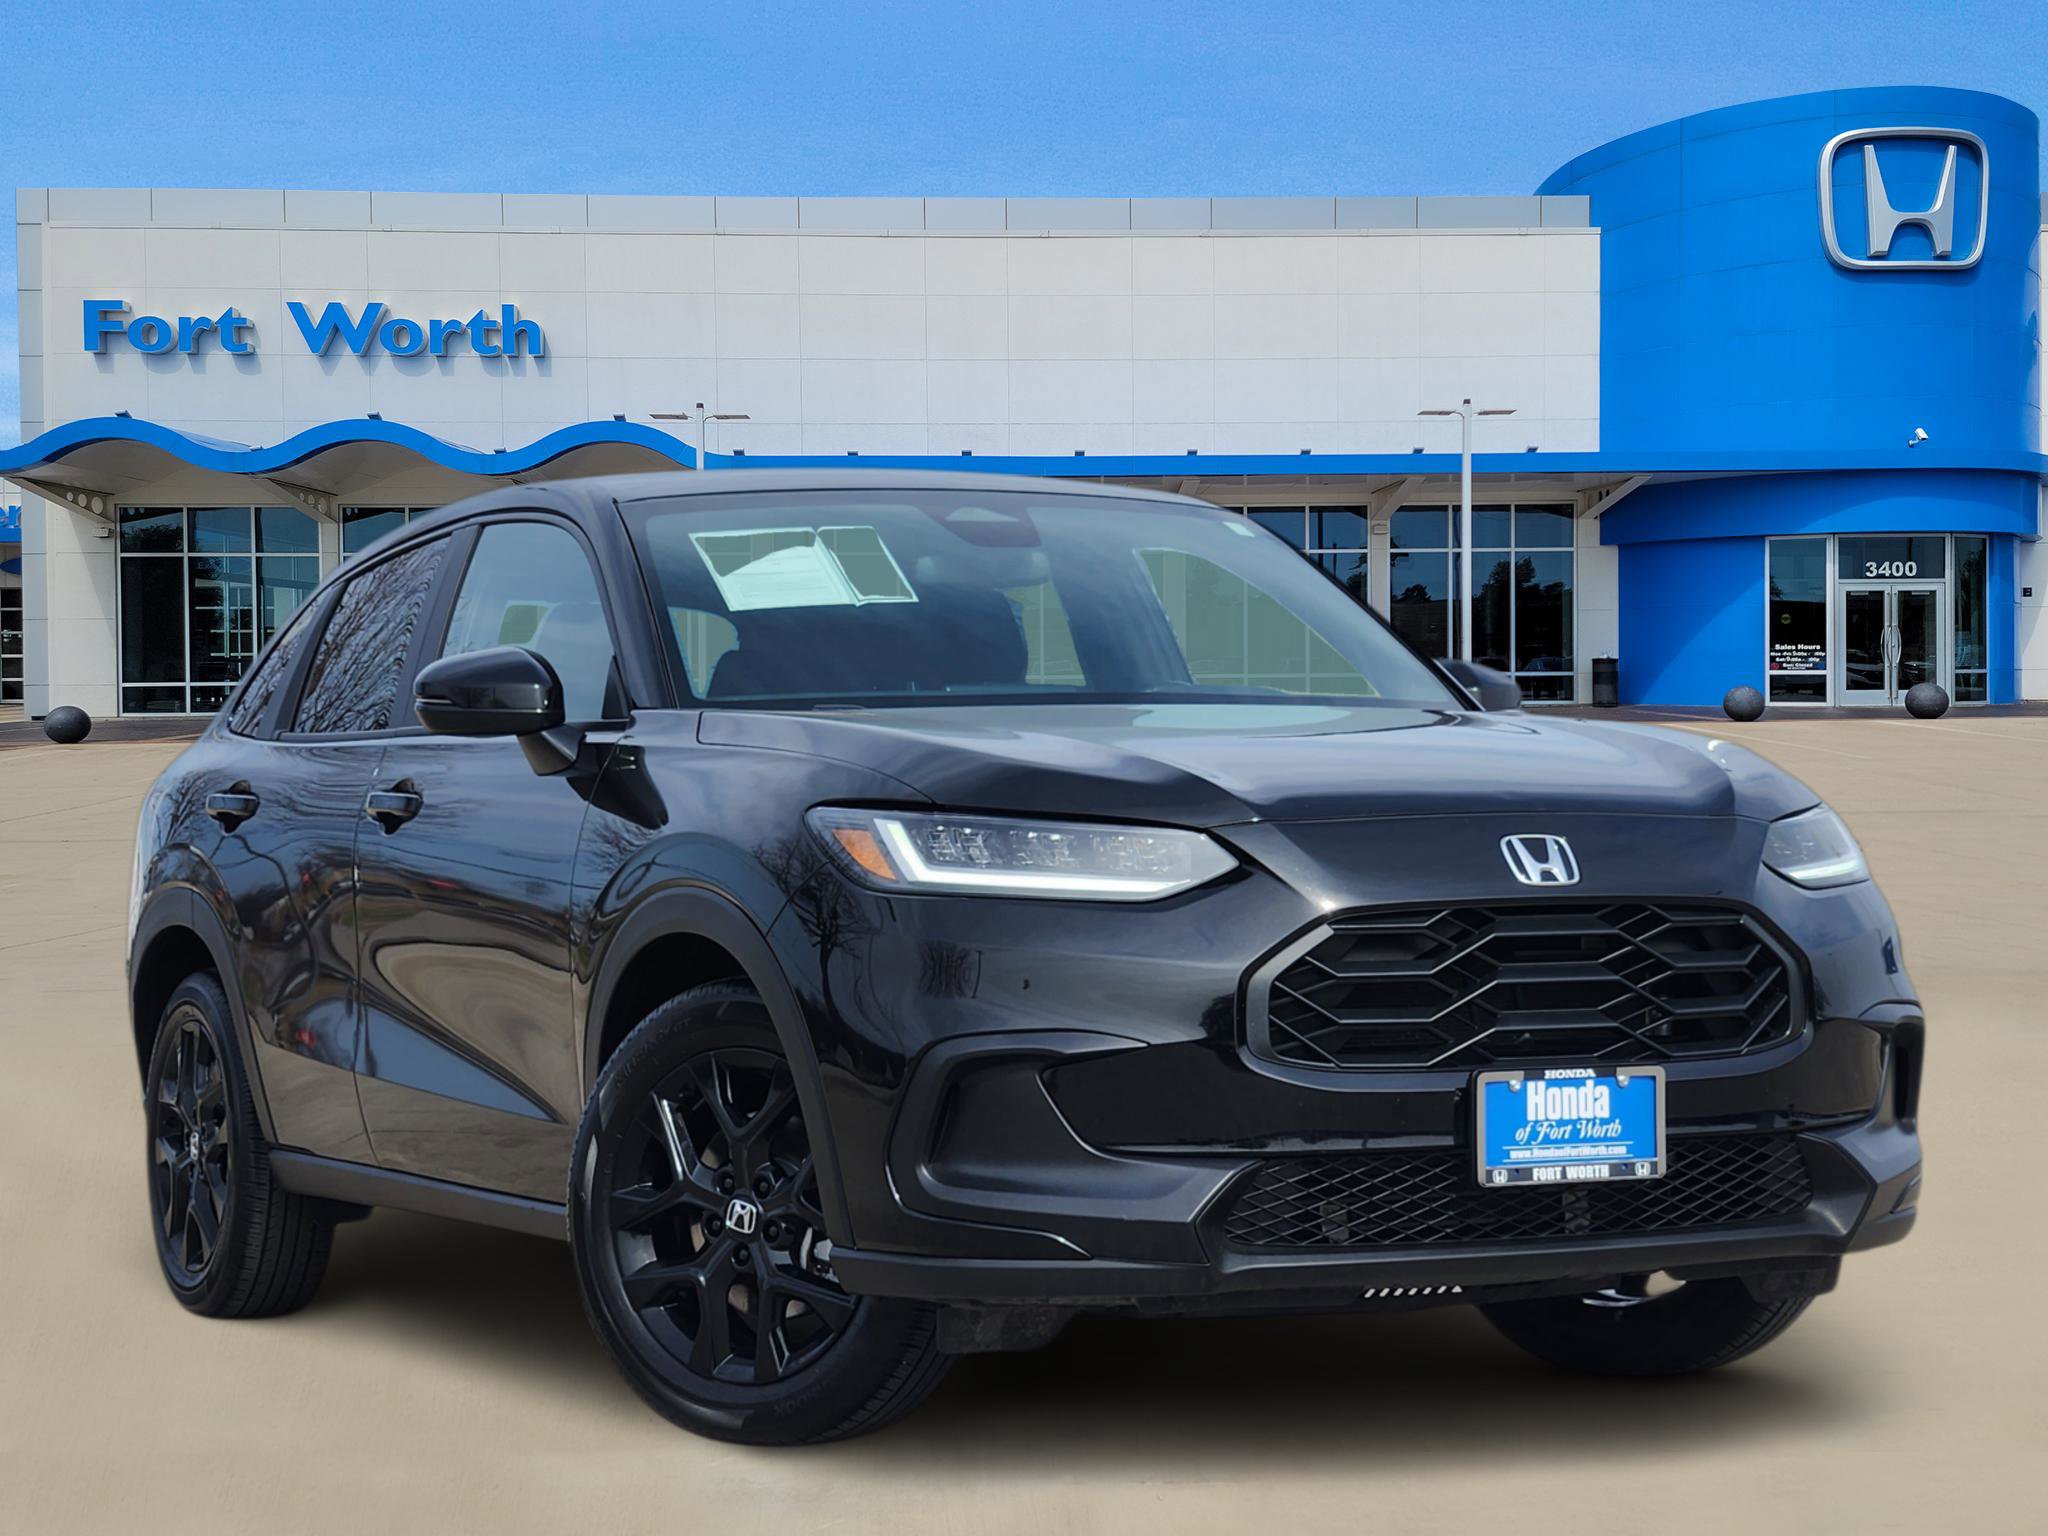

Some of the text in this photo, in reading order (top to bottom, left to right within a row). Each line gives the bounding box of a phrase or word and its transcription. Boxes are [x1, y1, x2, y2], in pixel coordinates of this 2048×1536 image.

[83, 299, 545, 358] Fort Worth
[1865, 561, 1917, 577] 3400
[1543, 1068, 1596, 1079] HONDA
[1526, 1079, 1610, 1121] Honda
[1515, 1119, 1622, 1145] of Fort Worth
[1532, 1164, 1610, 1181] FORT WORTH
